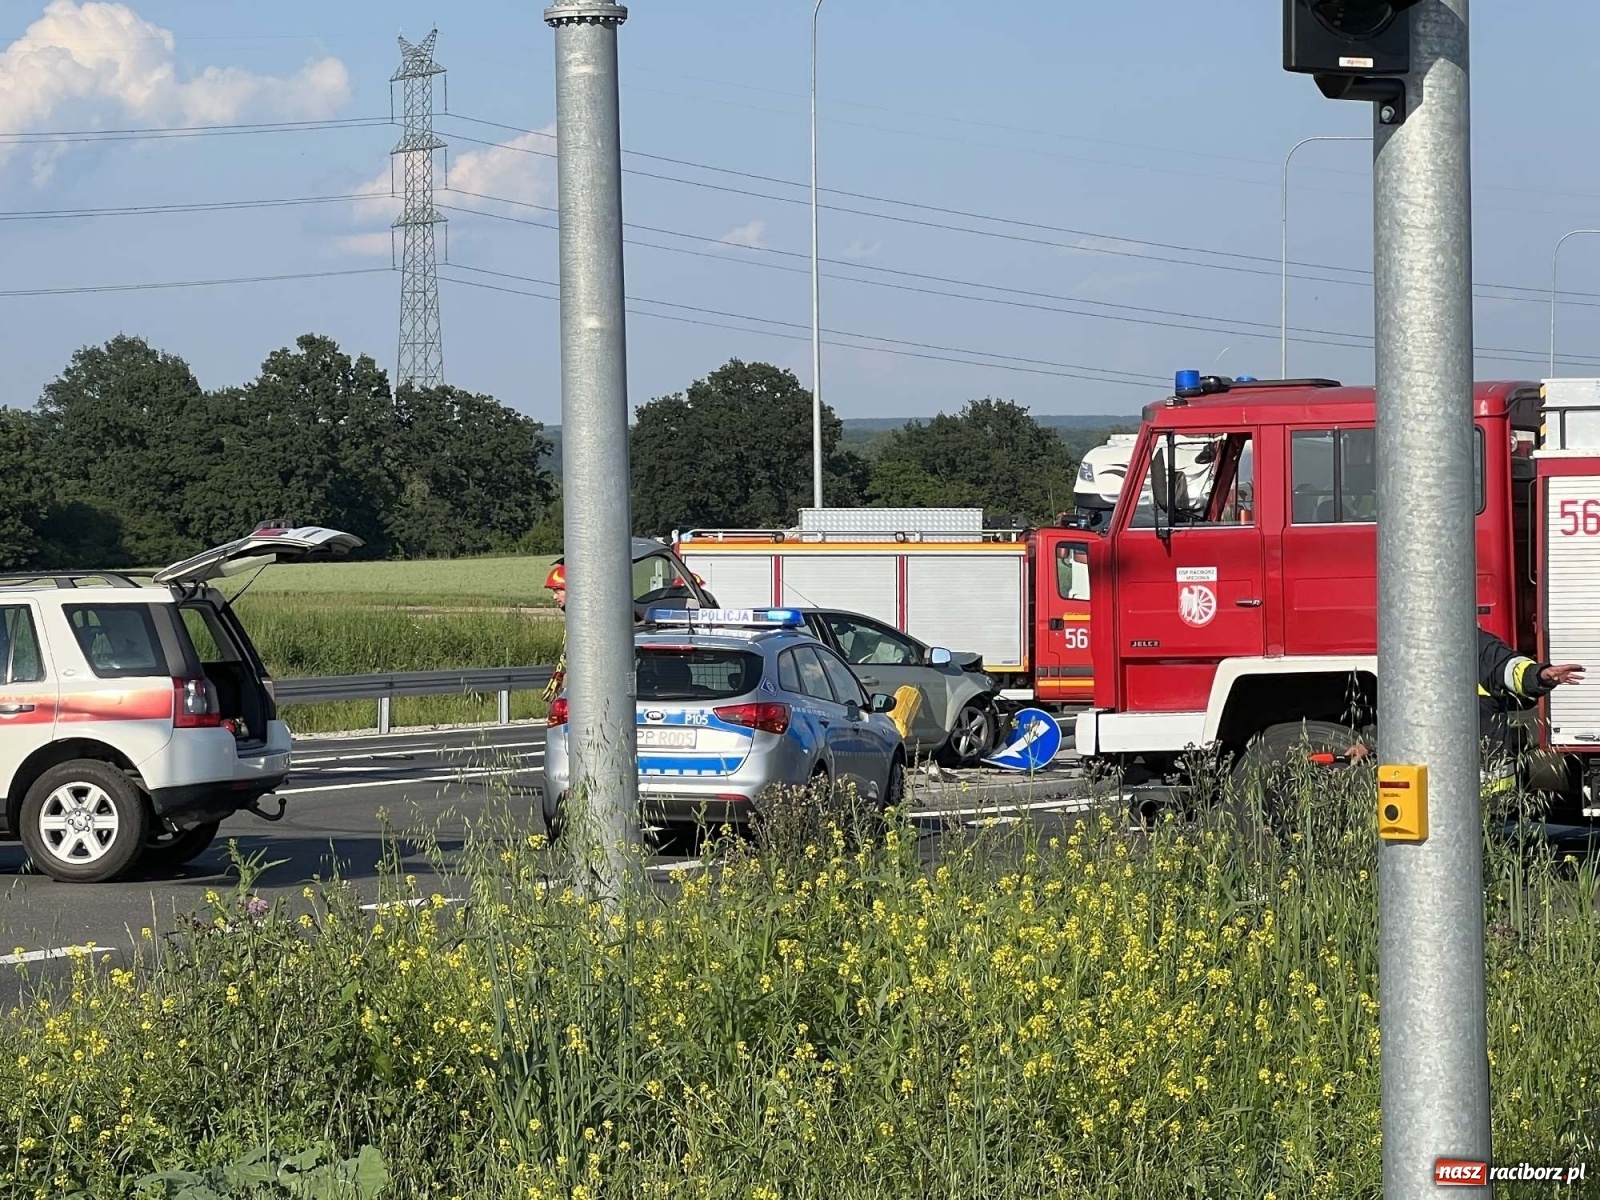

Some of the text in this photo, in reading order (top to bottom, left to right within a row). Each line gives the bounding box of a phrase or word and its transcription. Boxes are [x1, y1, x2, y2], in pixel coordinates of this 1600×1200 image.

[1560, 500, 1600, 536] 56
[700, 610, 750, 622] POLICJA
[1065, 628, 1089, 649] 56
[685, 714, 709, 725] P105
[659, 731, 694, 746] R005
